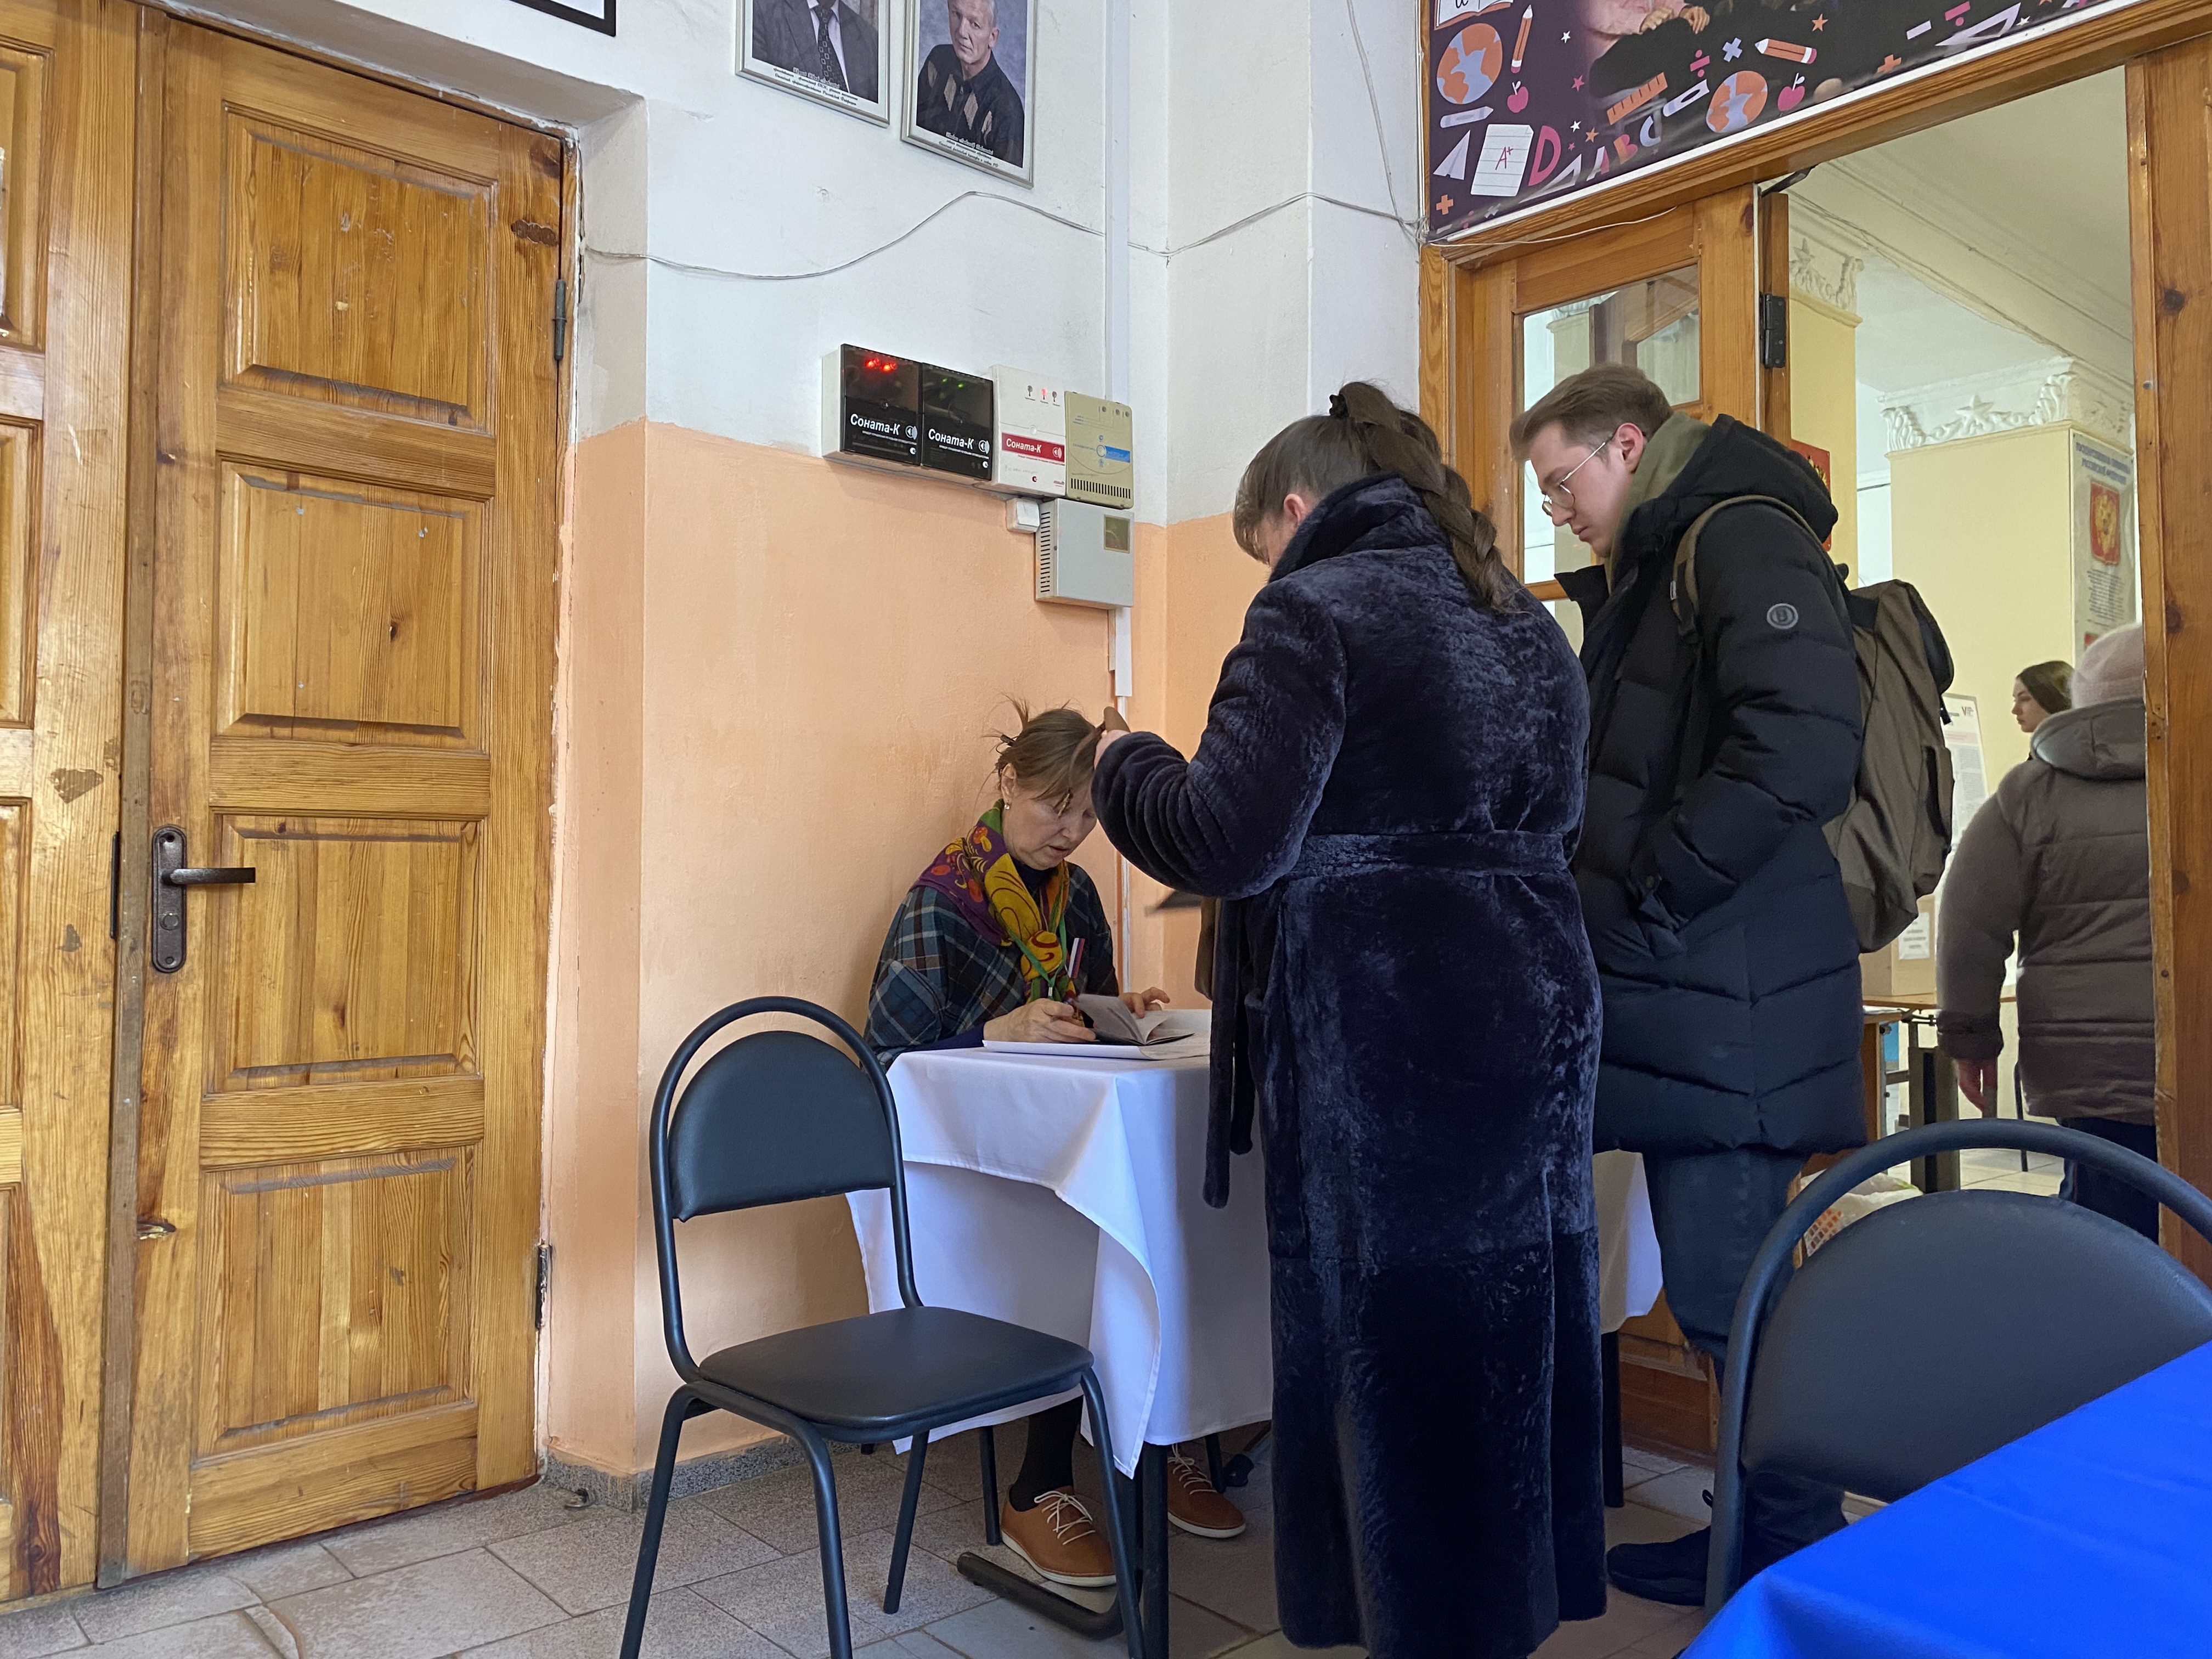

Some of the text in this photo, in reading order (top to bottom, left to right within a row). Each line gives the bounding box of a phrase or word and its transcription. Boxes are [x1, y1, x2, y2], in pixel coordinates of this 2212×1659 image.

[1495, 146, 1514, 171] A+
[850, 413, 901, 436] Соната-К
[928, 428, 974, 450] Соната-К
[1006, 438, 1042, 454] Соната-К
